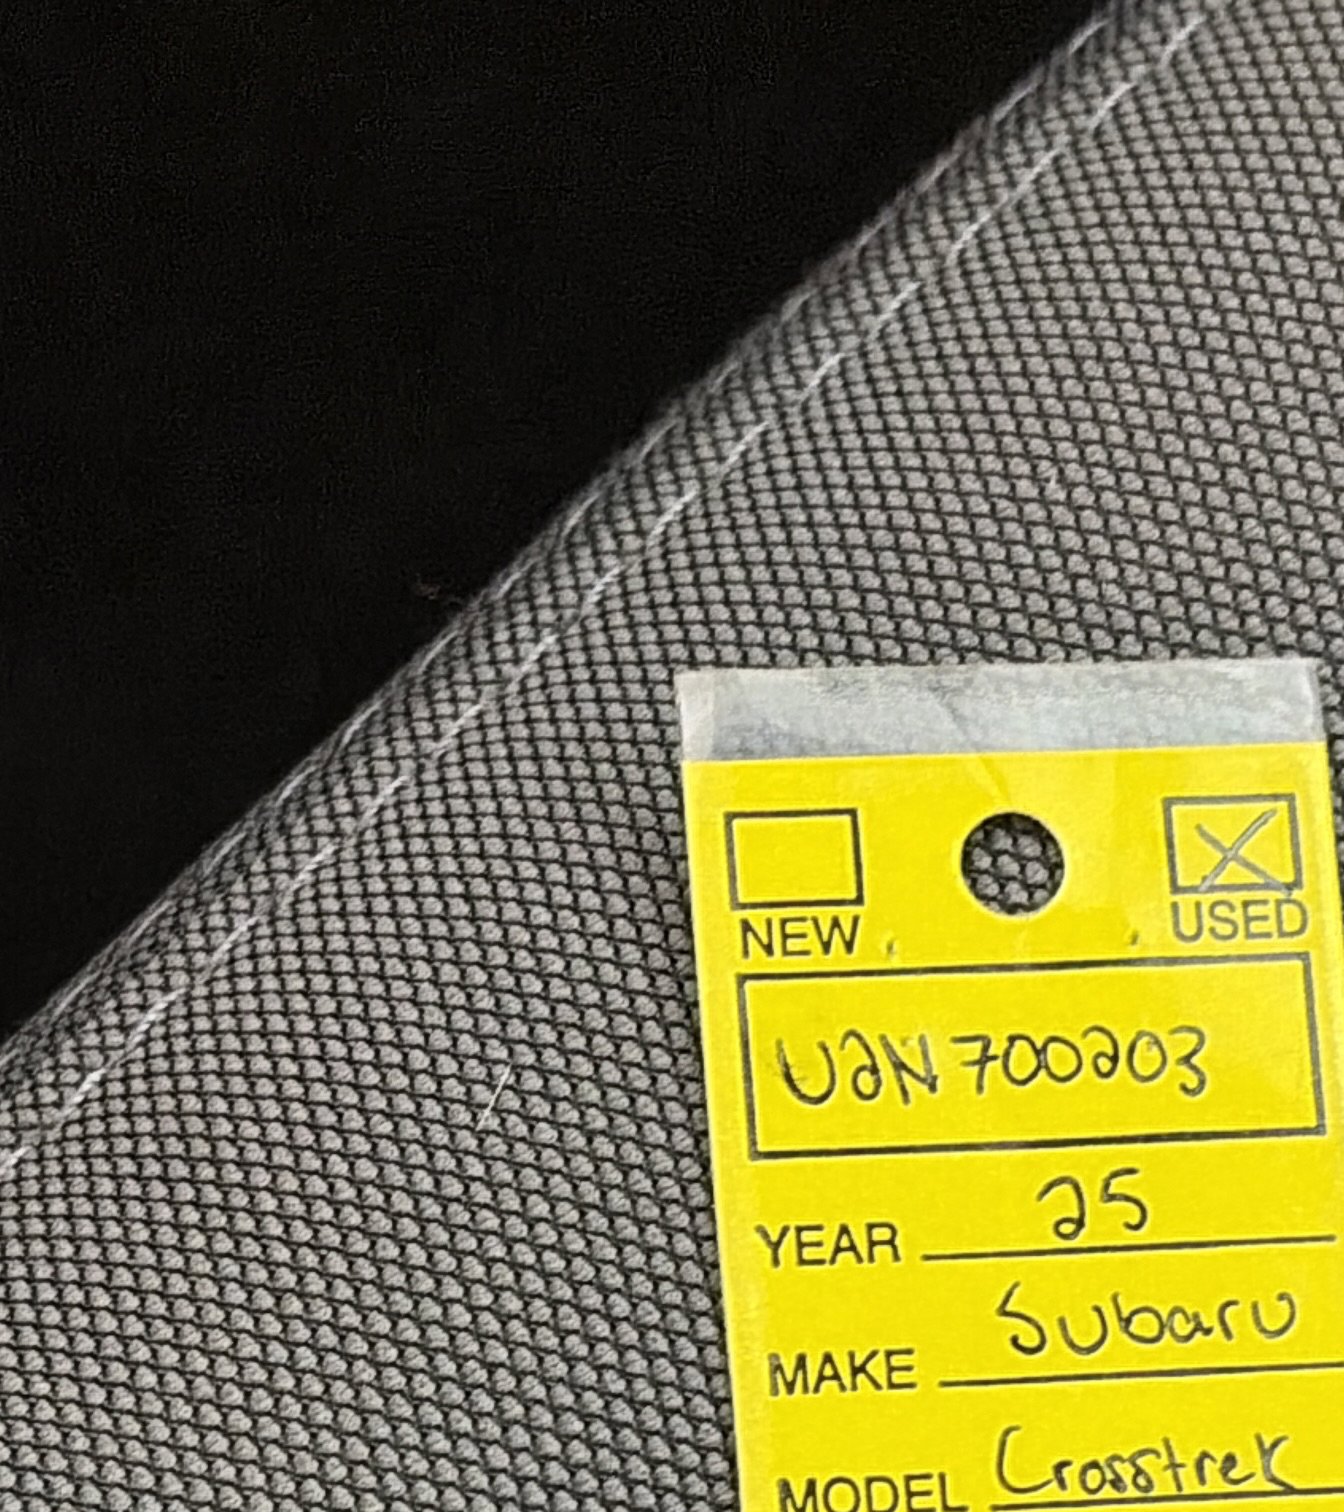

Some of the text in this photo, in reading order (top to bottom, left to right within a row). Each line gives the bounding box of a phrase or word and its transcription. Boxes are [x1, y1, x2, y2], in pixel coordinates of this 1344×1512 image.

[740, 914, 860, 960] NEW
[1172, 899, 1309, 942] USED
[1036, 1168, 1149, 1240] 25
[755, 1223, 902, 1268] YEAR
[996, 1281, 1297, 1355] Subaru
[768, 1348, 917, 1398] MAKE
[996, 1426, 1297, 1495] Crosstrek
